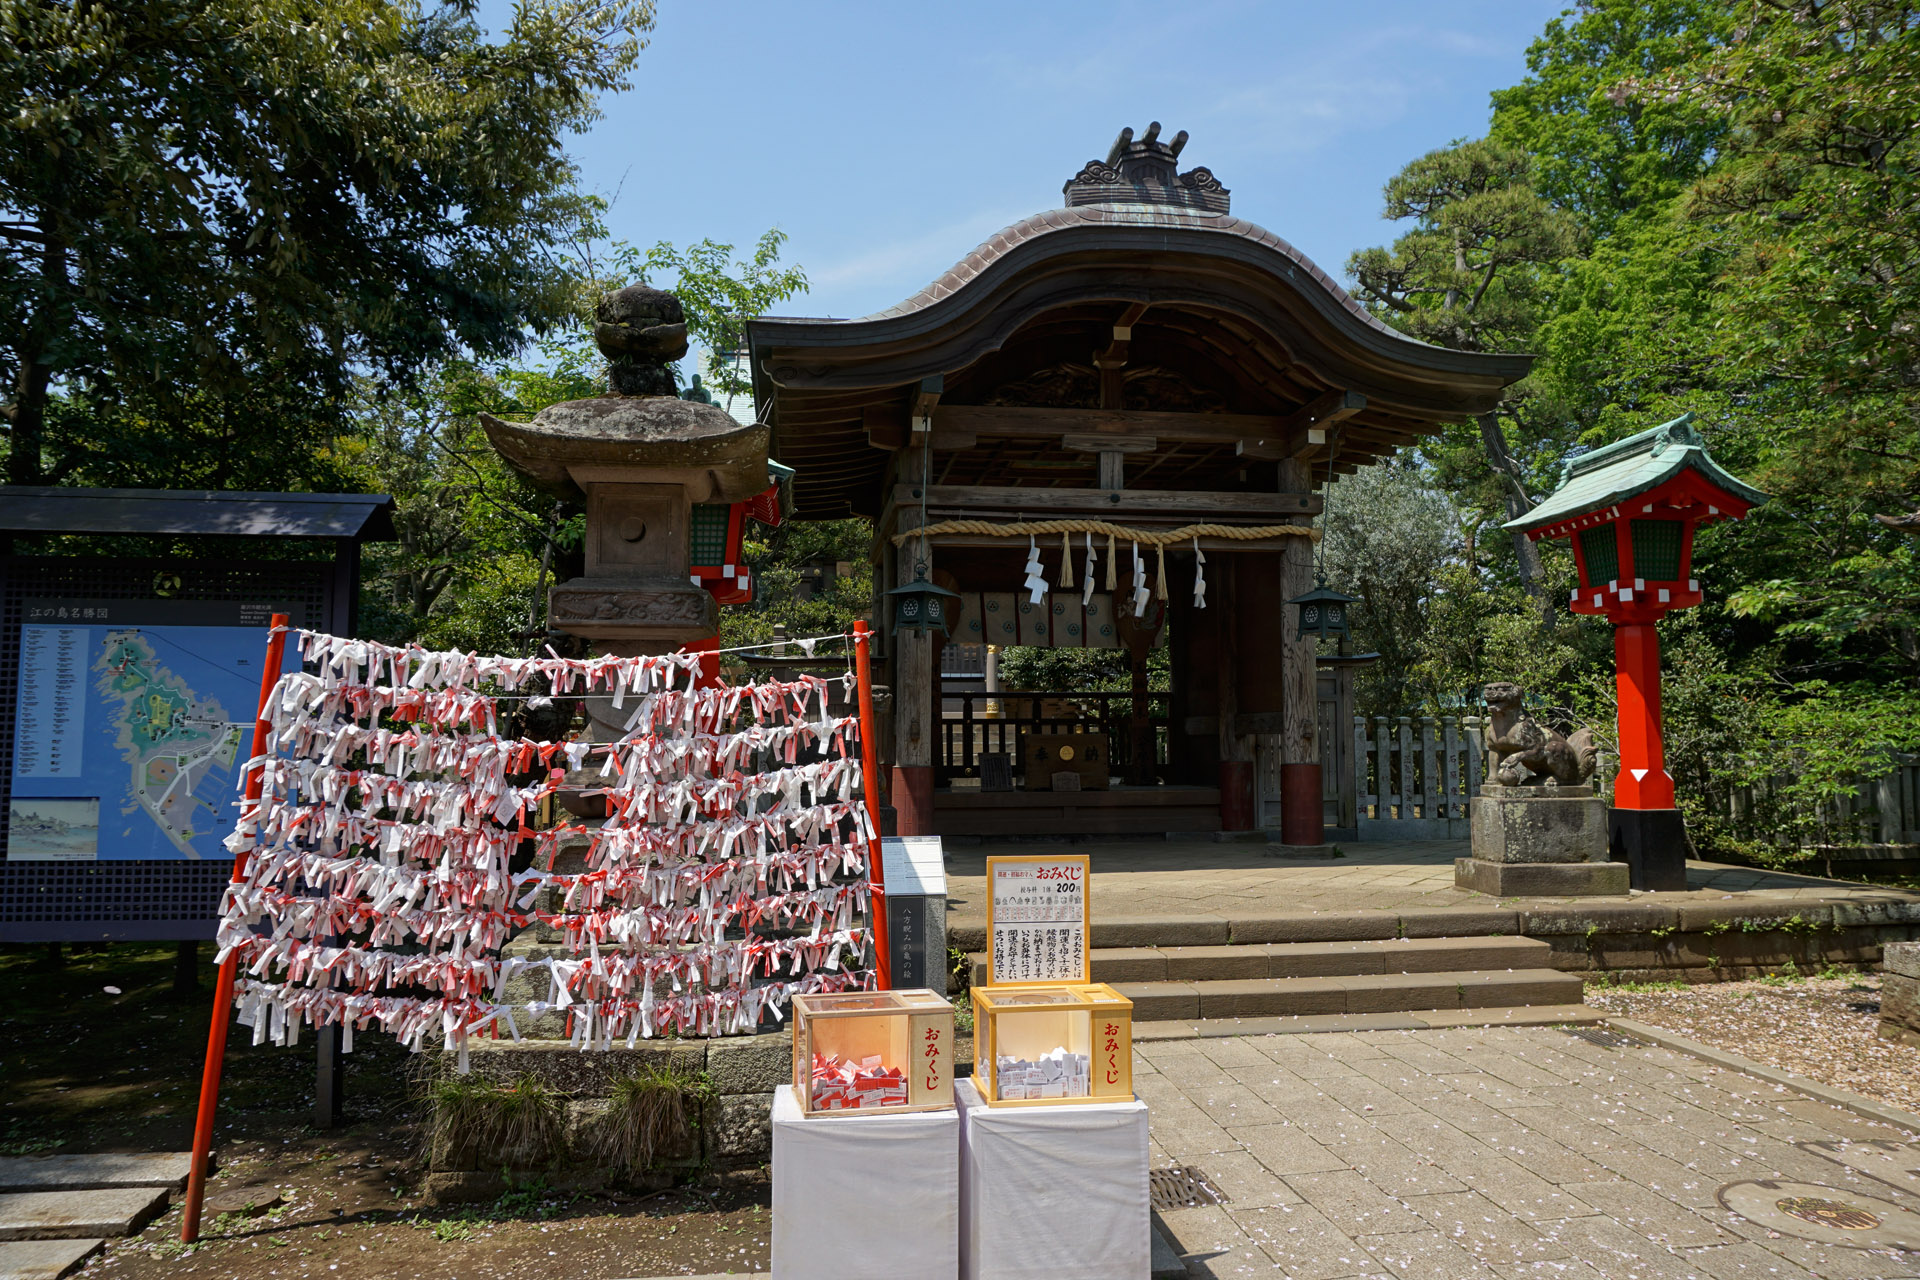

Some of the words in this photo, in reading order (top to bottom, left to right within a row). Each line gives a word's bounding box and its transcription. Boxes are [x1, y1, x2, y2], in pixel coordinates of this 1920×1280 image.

[29, 606, 109, 620] 江の島名勝図
[1036, 866, 1082, 881] おみくじ
[1056, 883, 1081, 893] 200円
[902, 907, 912, 979] 八方睨みの亀の絵
[924, 1027, 940, 1091] おみくじ
[1104, 1022, 1120, 1085] おみくじ
